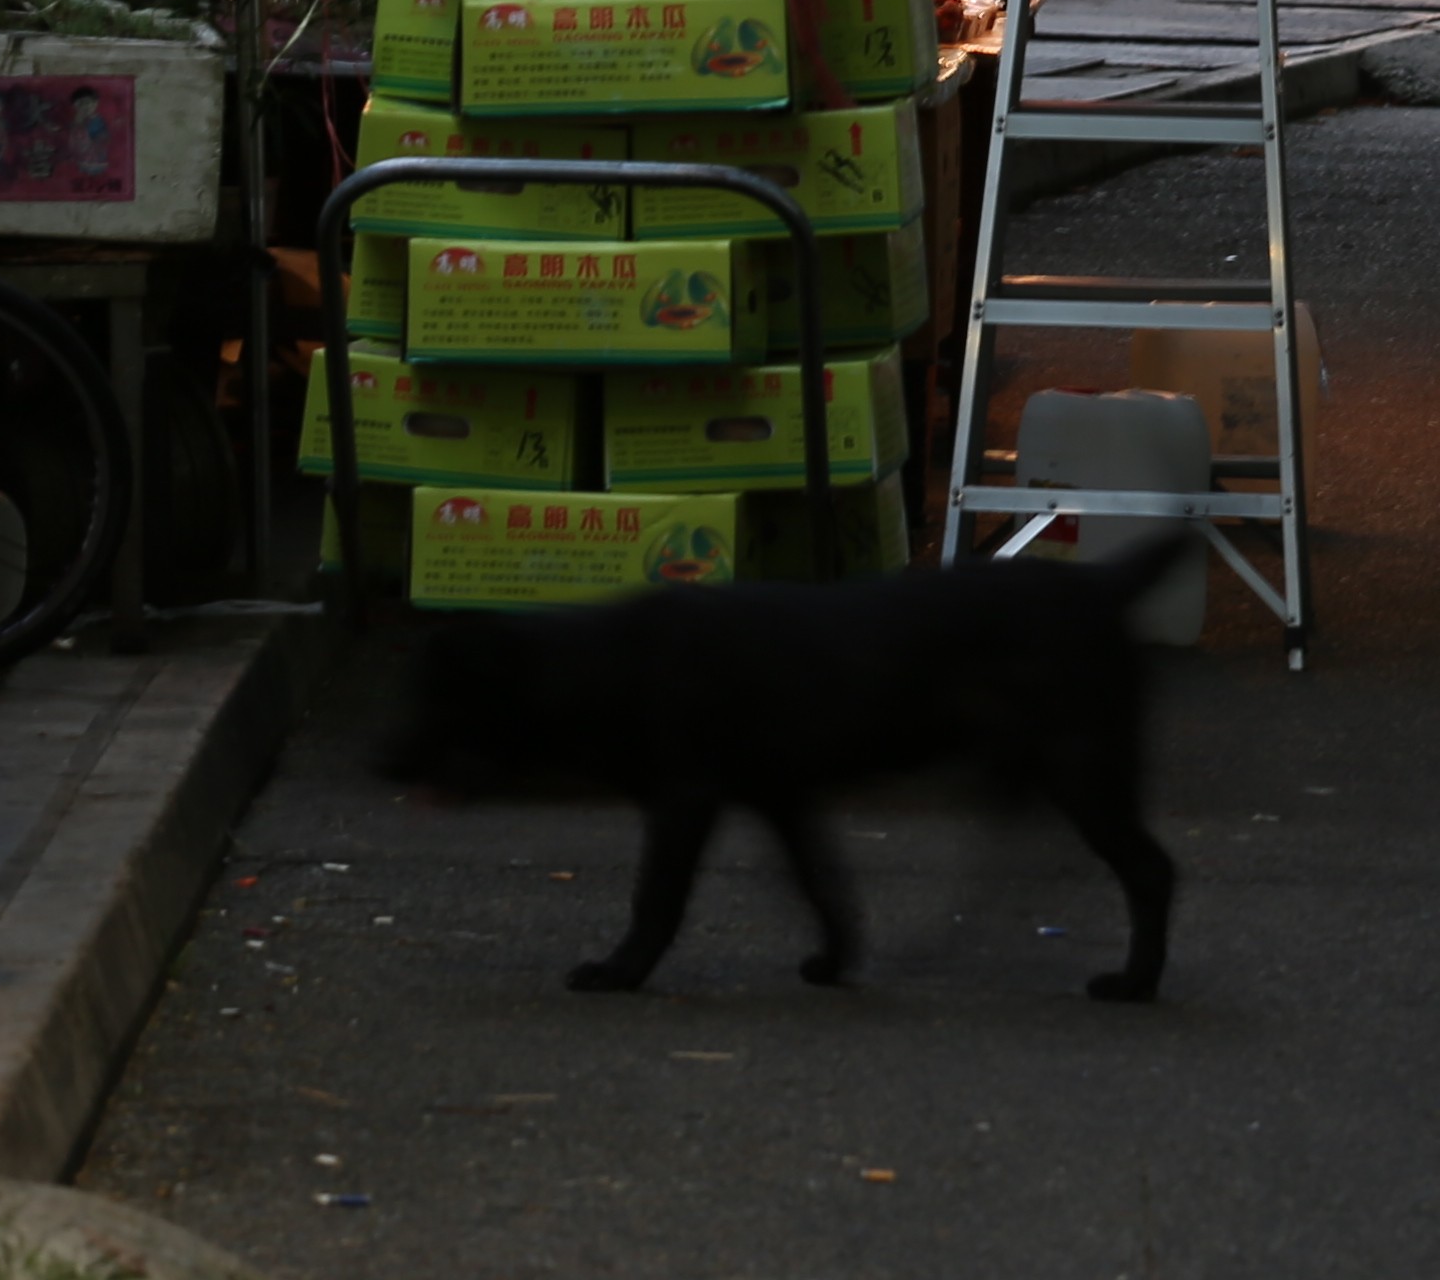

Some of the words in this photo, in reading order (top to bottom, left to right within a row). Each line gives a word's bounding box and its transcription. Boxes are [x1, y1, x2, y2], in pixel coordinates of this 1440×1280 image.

[552, 3, 687, 31] 高明木瓜
[503, 253, 638, 278] 高明木瓜
[506, 505, 641, 532] 高明木瓜
